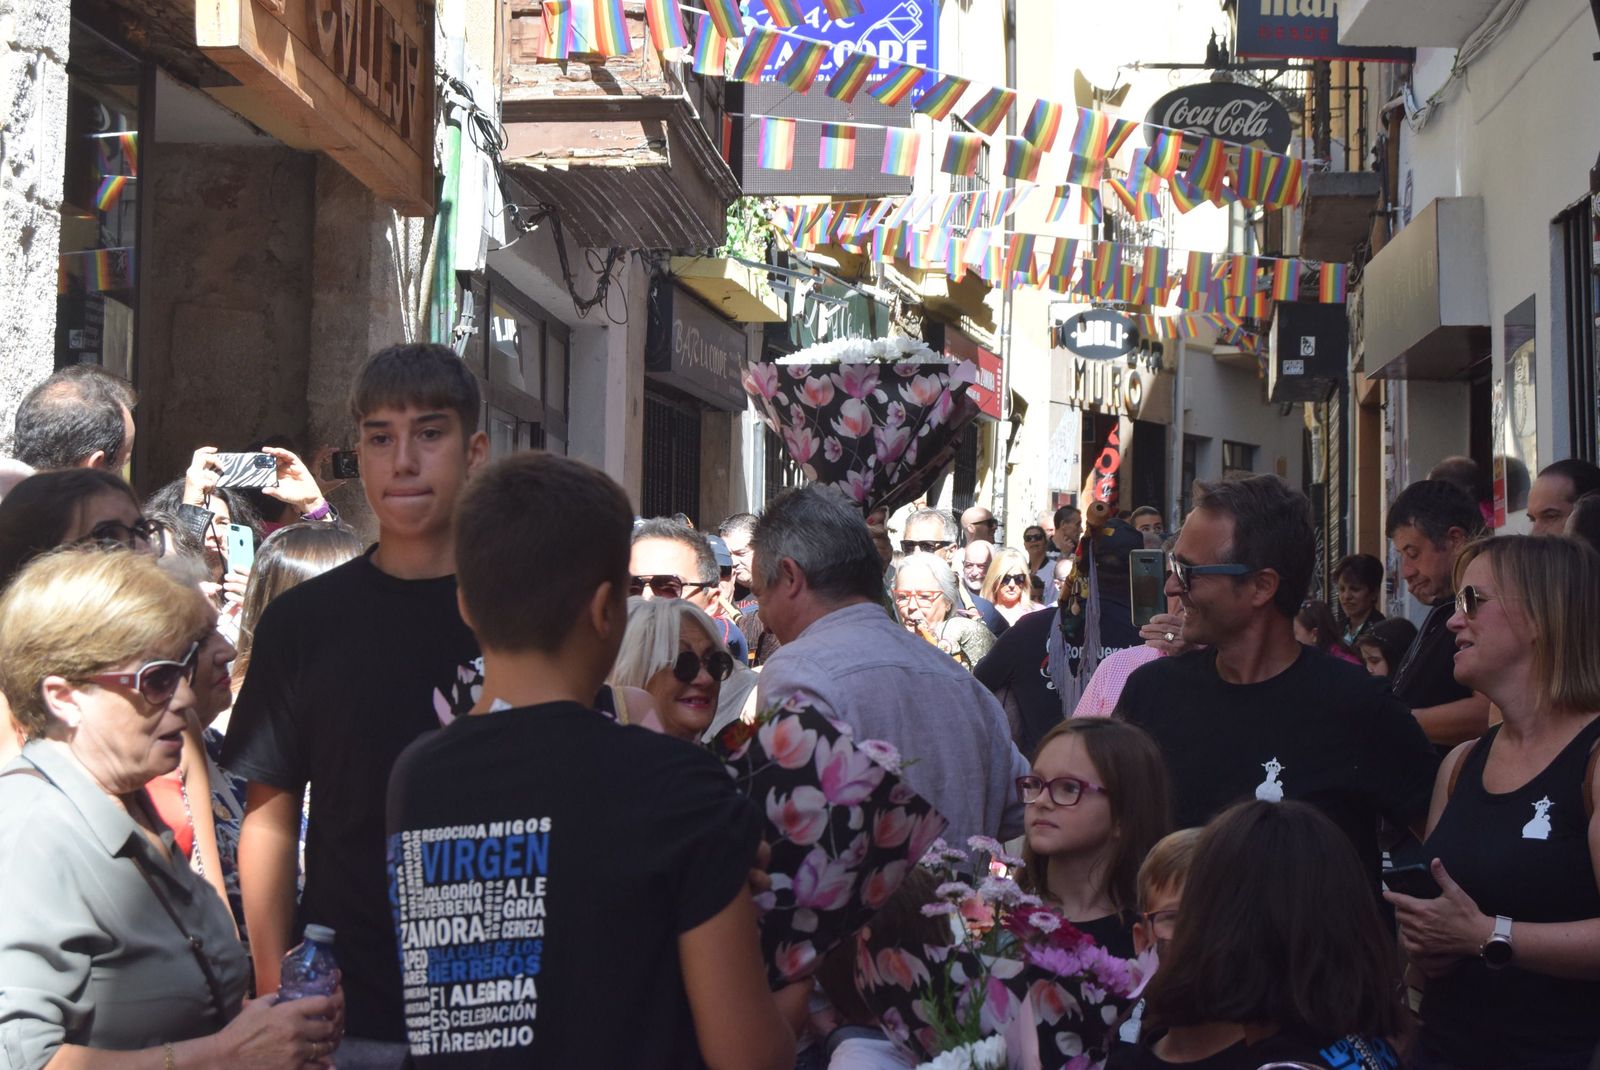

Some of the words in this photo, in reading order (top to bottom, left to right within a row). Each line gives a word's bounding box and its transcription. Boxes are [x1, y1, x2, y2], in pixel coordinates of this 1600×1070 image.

[1163, 97, 1274, 137] Coca-Cola
[673, 319, 700, 368] BAR
[1069, 356, 1143, 418] MURO
[475, 816, 552, 840] AMIGOS
[421, 833, 550, 884] VIRGEN
[402, 831, 417, 919] SOLEMNIDAD
[504, 876, 548, 899] ALE
[424, 898, 484, 919] VERBENA
[400, 914, 486, 949] ZAMORA
[501, 918, 545, 939] CERVEZA
[494, 940, 512, 956] DE
[514, 939, 544, 955] LOS
[428, 953, 543, 985] HERREROS
[450, 973, 538, 1008] ALEGRÍA
[450, 1002, 537, 1028] CELEBRACIÓN
[451, 1025, 535, 1053] REGOCIJO
